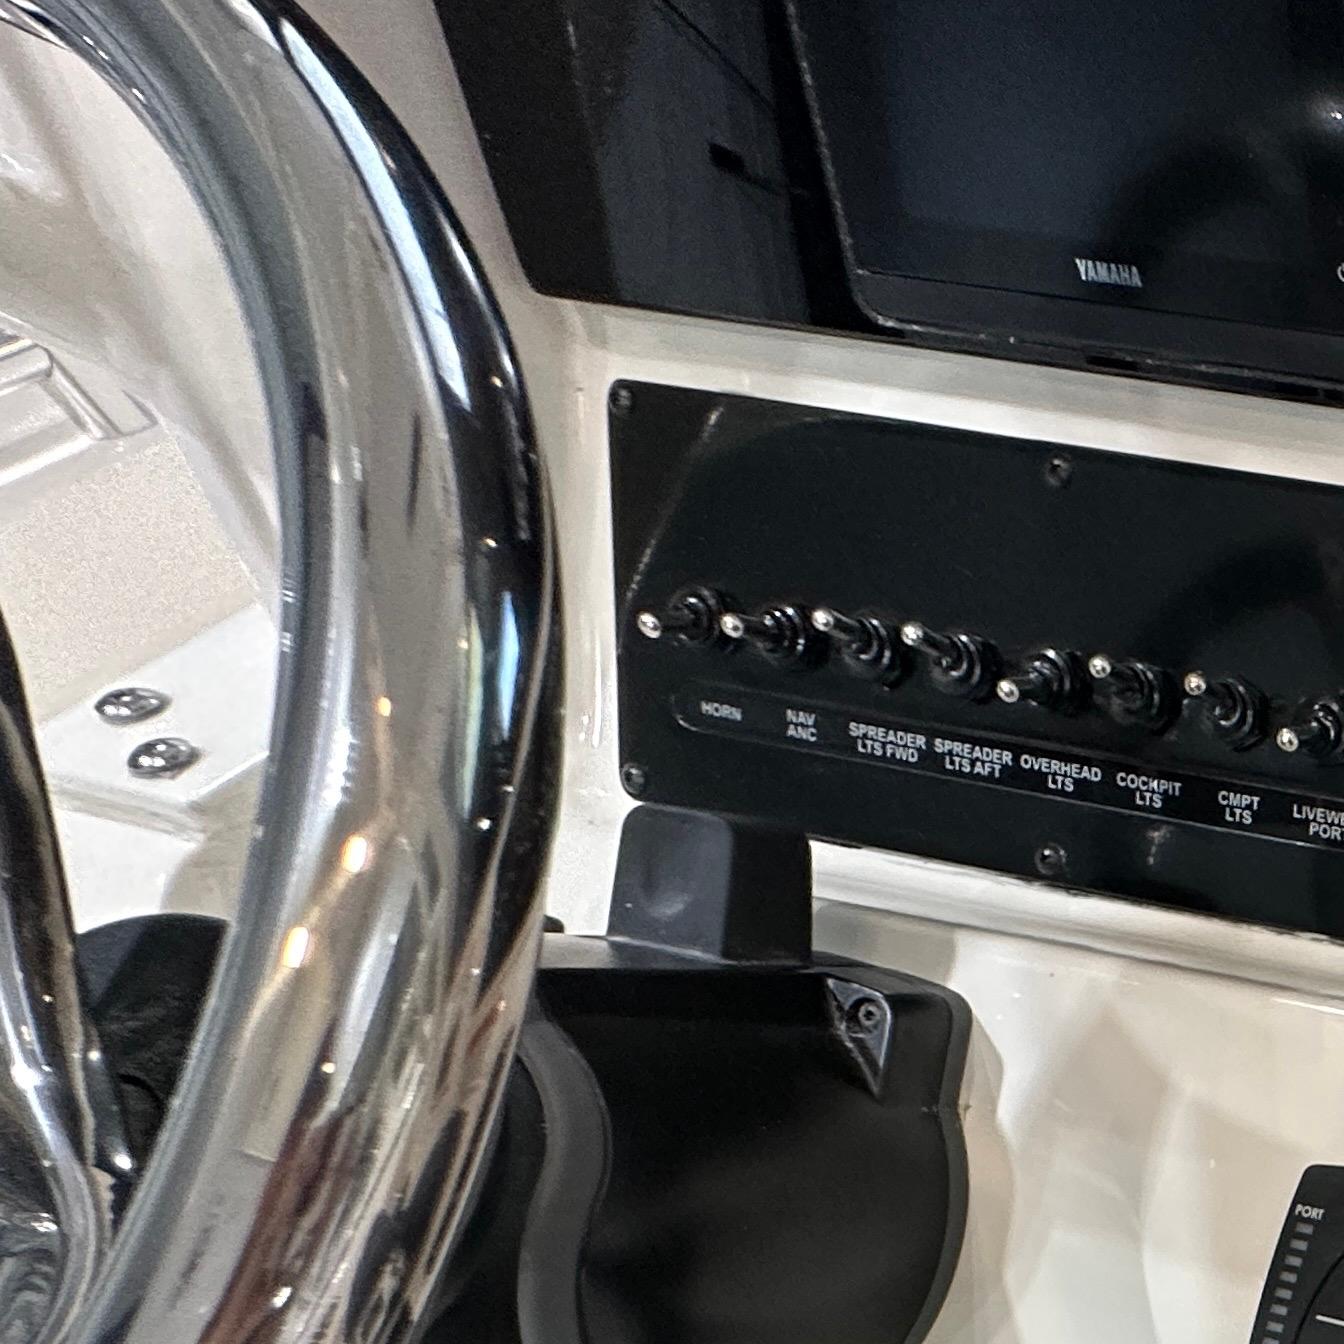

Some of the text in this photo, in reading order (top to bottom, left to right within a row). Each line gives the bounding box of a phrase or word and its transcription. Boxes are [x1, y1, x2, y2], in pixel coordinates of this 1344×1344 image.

[1074, 257, 1143, 287] YAMAHA
[700, 701, 742, 721] HORN
[786, 708, 816, 726] NAV
[787, 724, 817, 742] ANC
[849, 722, 927, 750] SPREADER
[857, 738, 919, 763] LTS FWD
[934, 739, 1013, 766] SPREADER
[944, 755, 1002, 778] LTS AFT
[1019, 754, 1102, 782] OVERHEAD
[1047, 774, 1074, 793] LTS
[1116, 772, 1182, 796] COCKPIT
[1135, 790, 1162, 809] LTS
[1217, 790, 1261, 811] CMPT
[1224, 807, 1253, 825] LTS
[1295, 1204, 1324, 1221] PORT
